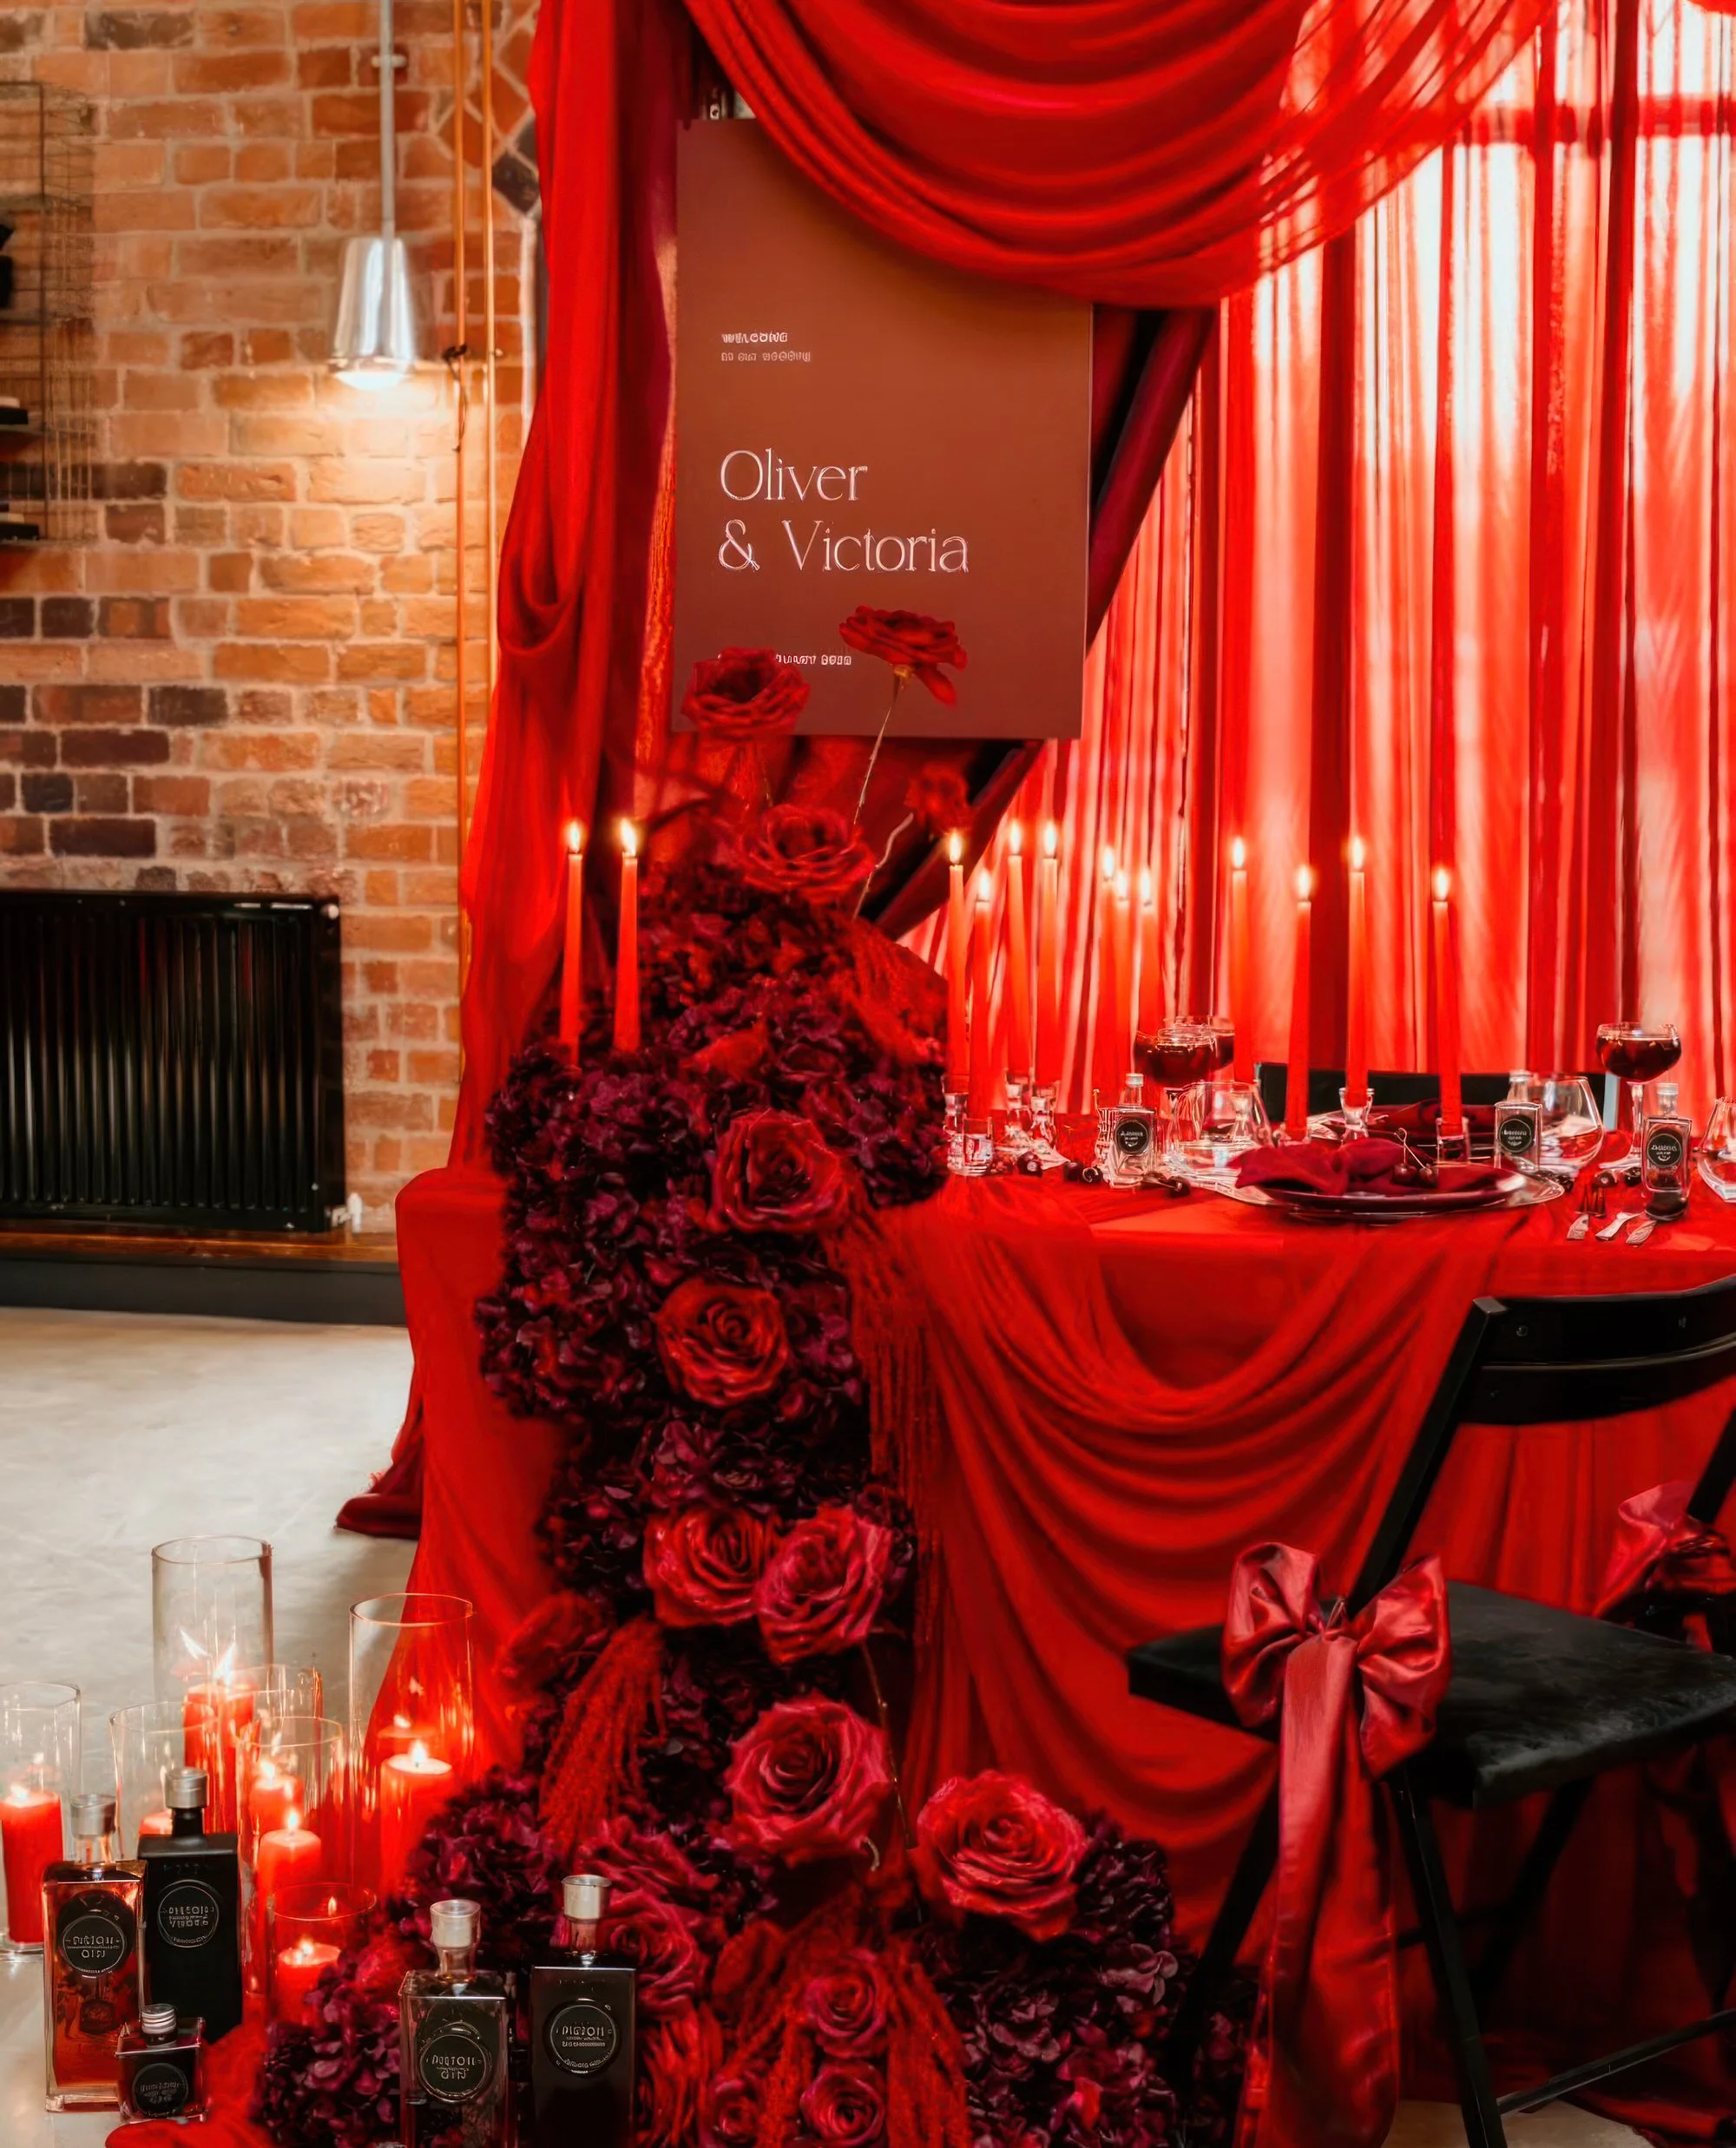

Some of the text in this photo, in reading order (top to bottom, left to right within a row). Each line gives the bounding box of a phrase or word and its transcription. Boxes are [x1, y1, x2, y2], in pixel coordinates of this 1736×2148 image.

[720, 448, 868, 501] Oliver
[718, 519, 969, 573] & Victoria
